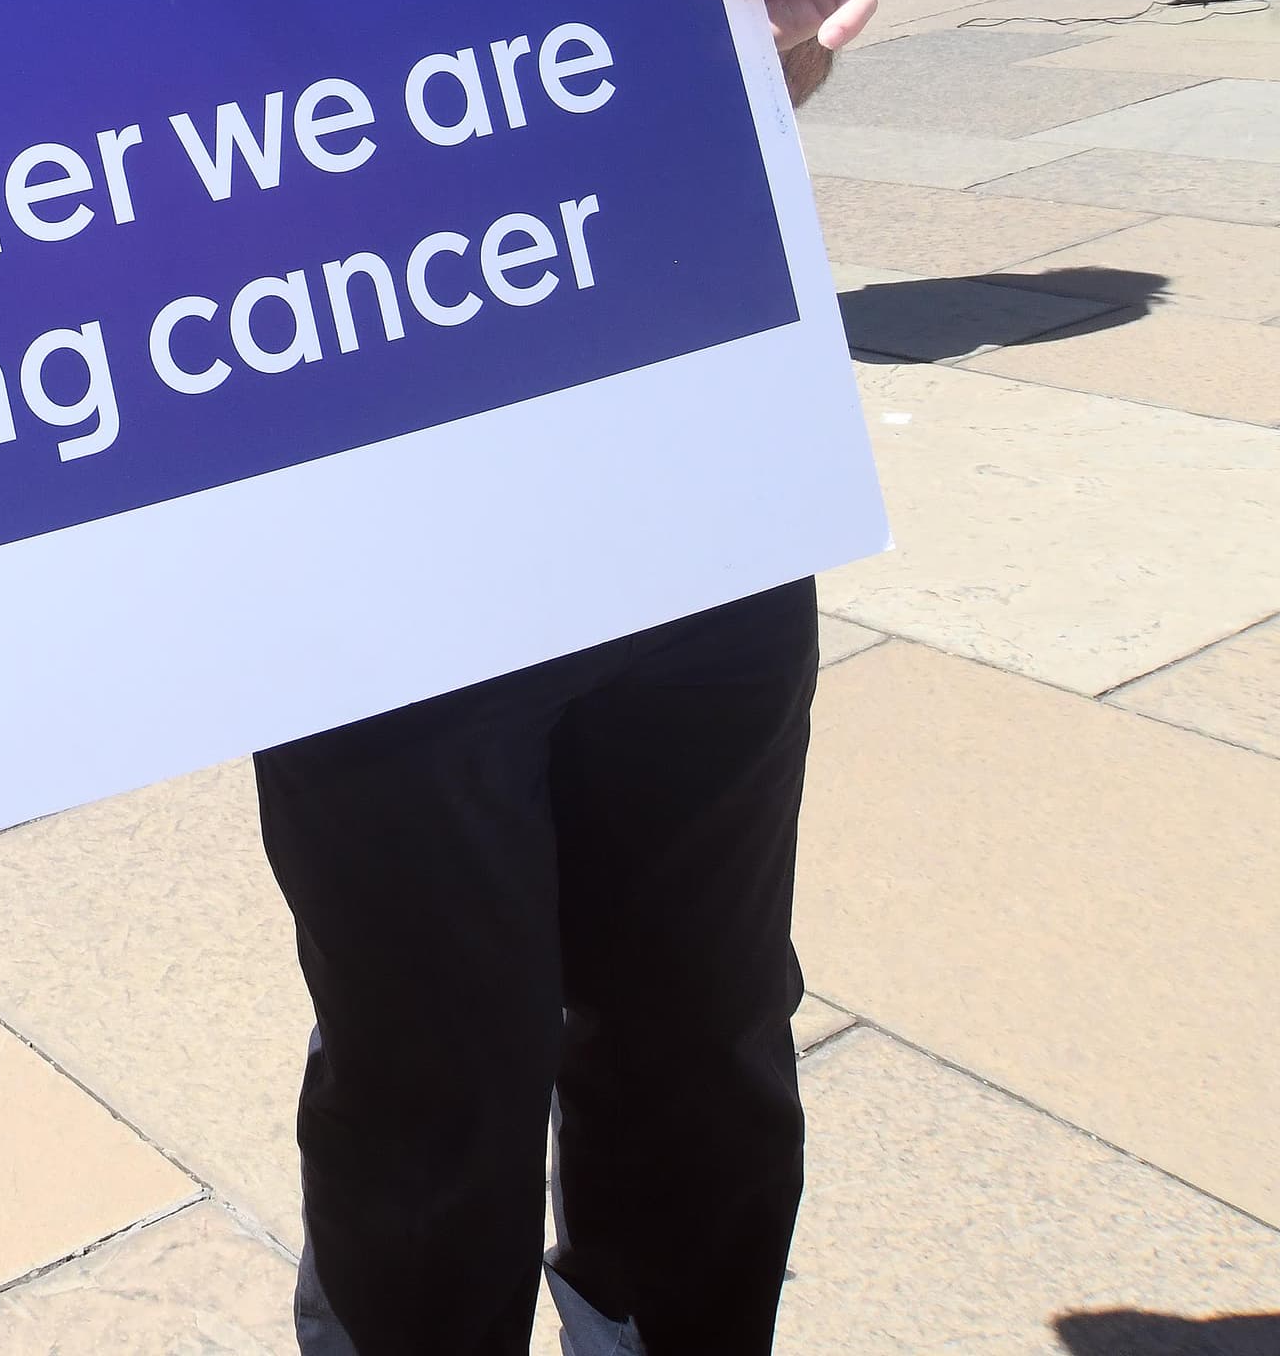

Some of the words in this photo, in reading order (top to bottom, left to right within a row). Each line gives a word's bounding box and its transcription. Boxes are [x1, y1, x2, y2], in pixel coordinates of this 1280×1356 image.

[168, 78, 377, 202] we
[404, 22, 617, 146] are
[149, 194, 600, 395] cancer
